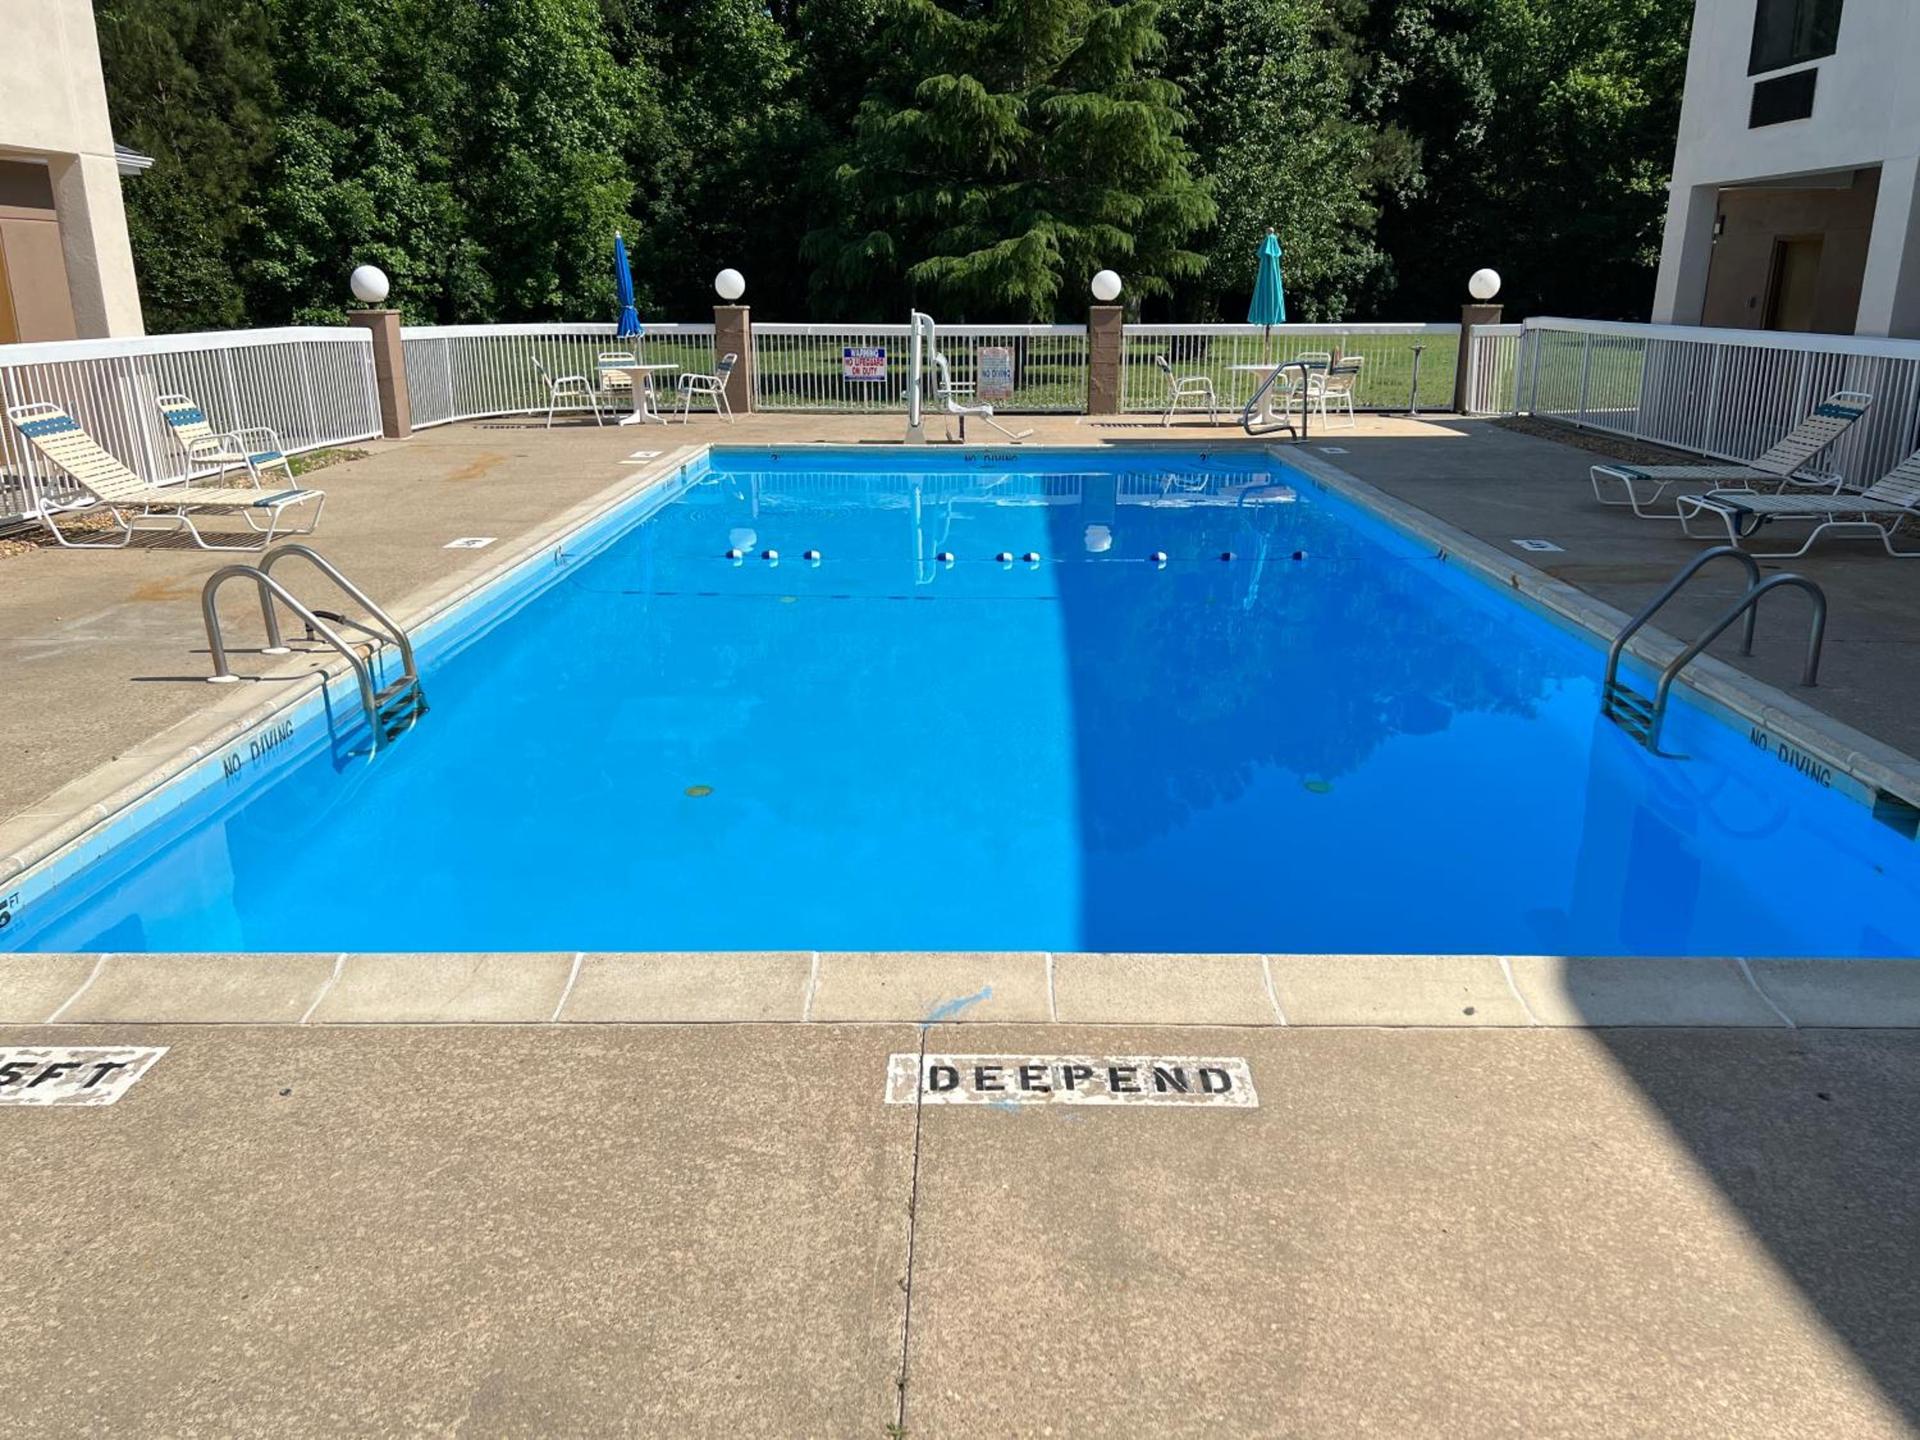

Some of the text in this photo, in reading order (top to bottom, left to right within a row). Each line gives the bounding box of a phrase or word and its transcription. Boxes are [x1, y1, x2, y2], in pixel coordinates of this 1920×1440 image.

[852, 367, 878, 375] ON DUTY
[854, 358, 884, 366] LIFEGUARD
[223, 719, 294, 778] NO DIVING
[1750, 726, 1831, 789] NO DIVING
